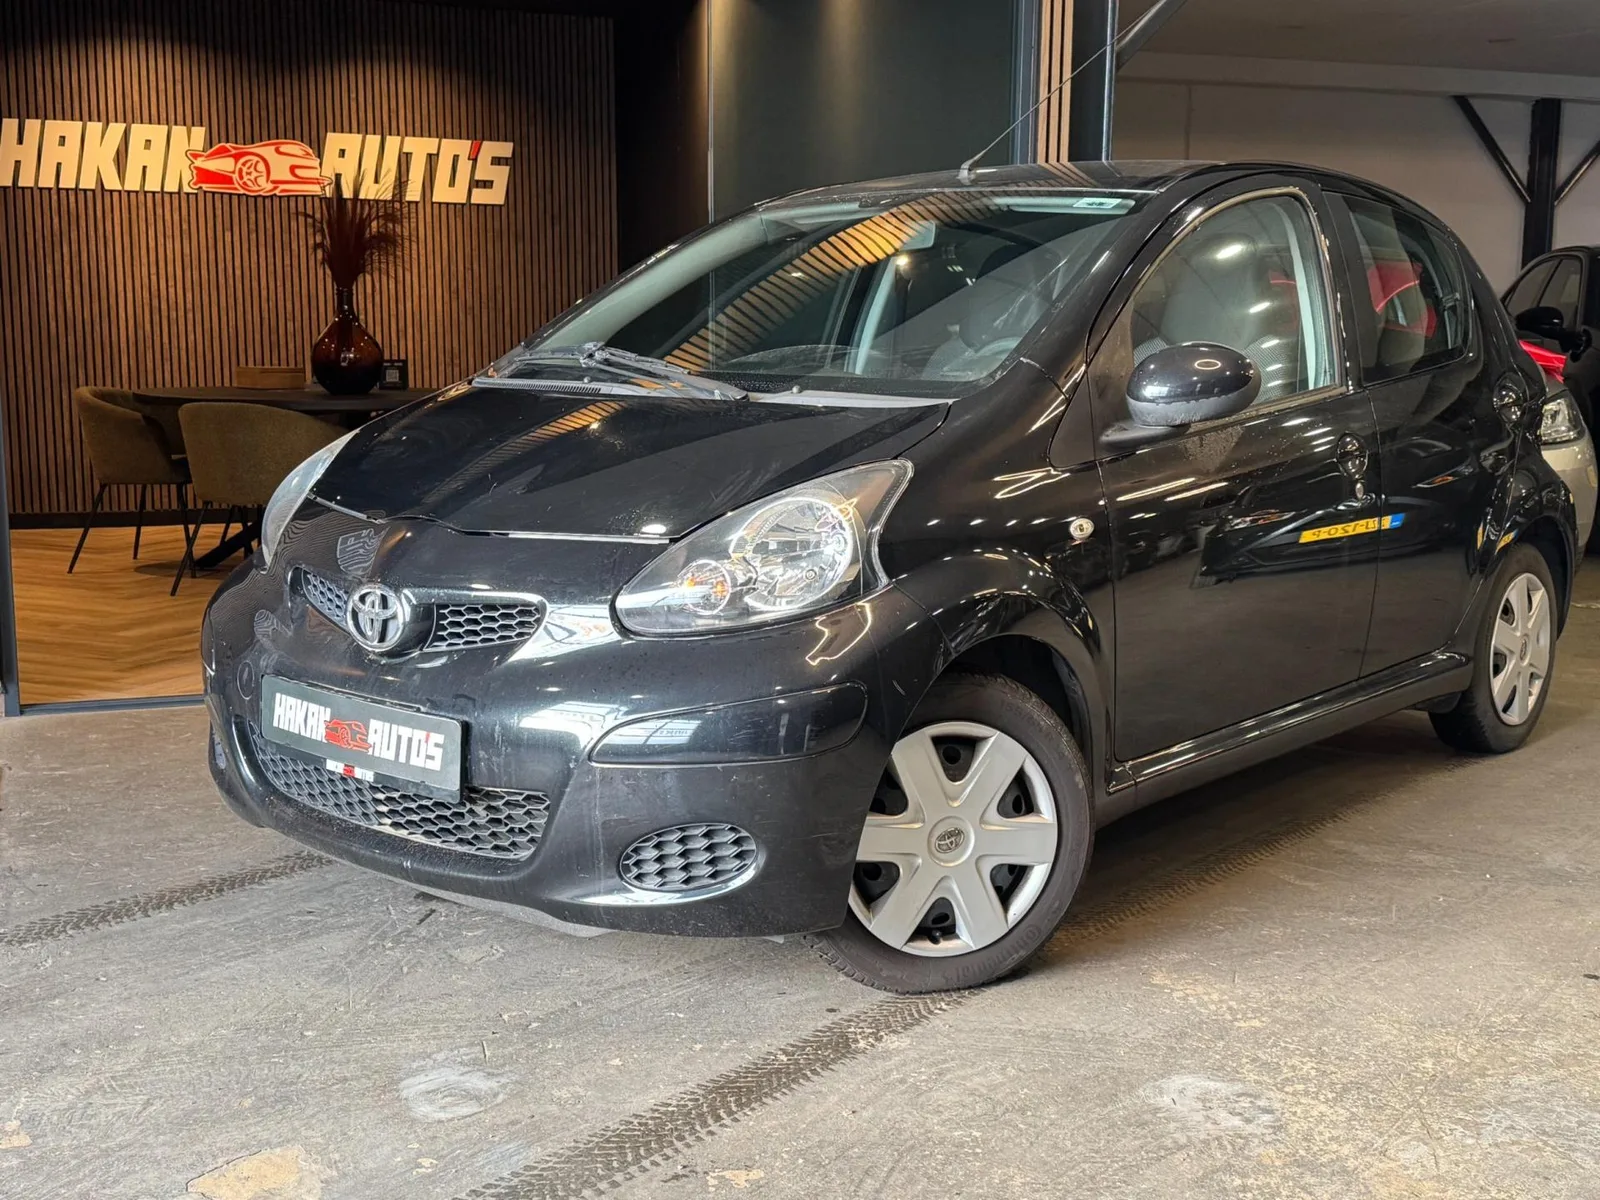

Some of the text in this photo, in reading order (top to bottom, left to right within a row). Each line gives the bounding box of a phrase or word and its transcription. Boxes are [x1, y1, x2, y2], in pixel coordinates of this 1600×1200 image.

[0, 118, 513, 205] HAKAN AUTO'S
[273, 692, 332, 743] HAKAN
[368, 718, 445, 771] AUTO'S
